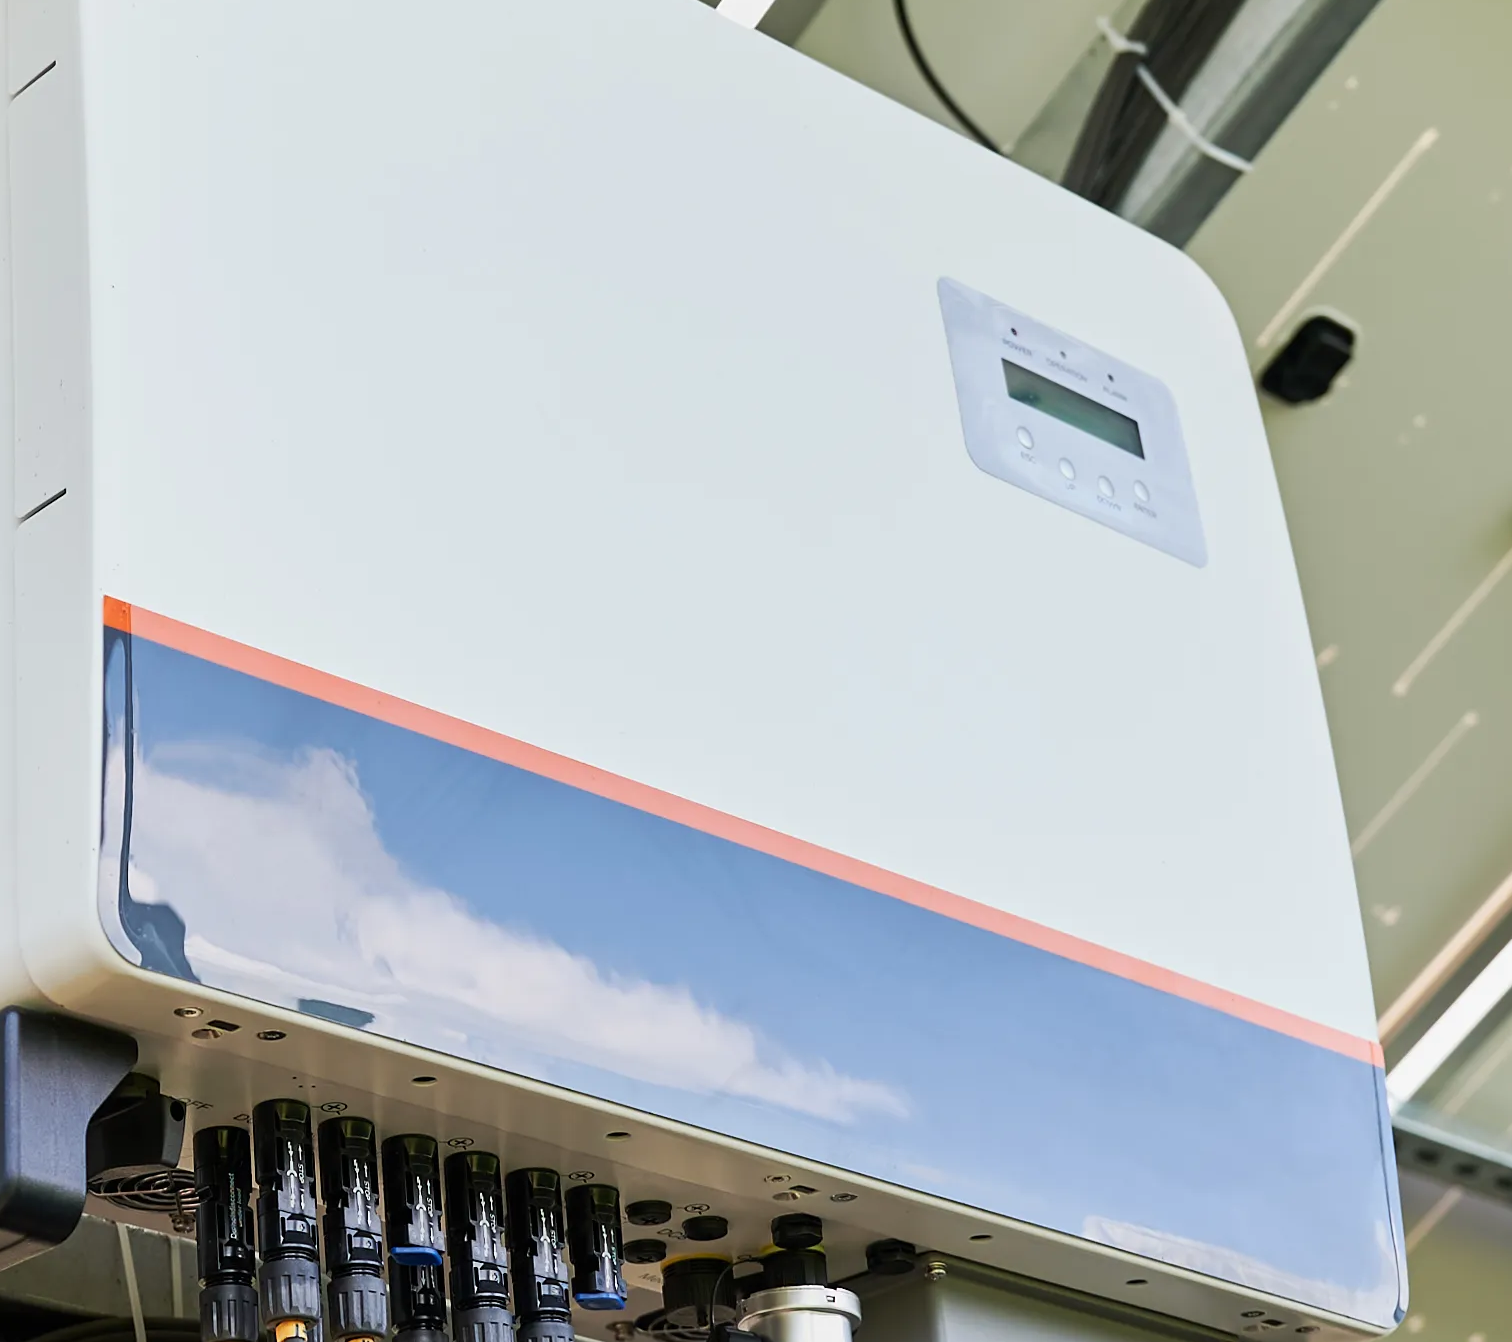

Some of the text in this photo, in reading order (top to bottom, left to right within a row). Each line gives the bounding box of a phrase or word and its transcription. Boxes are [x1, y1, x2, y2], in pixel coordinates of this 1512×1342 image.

[1001, 337, 1033, 357] POWER
[1020, 450, 1037, 466] ESC
[1096, 494, 1123, 512] DOWN
[1133, 502, 1158, 520] ENTER
[297, 1163, 305, 1184] STOP
[363, 1180, 372, 1202] STOP
